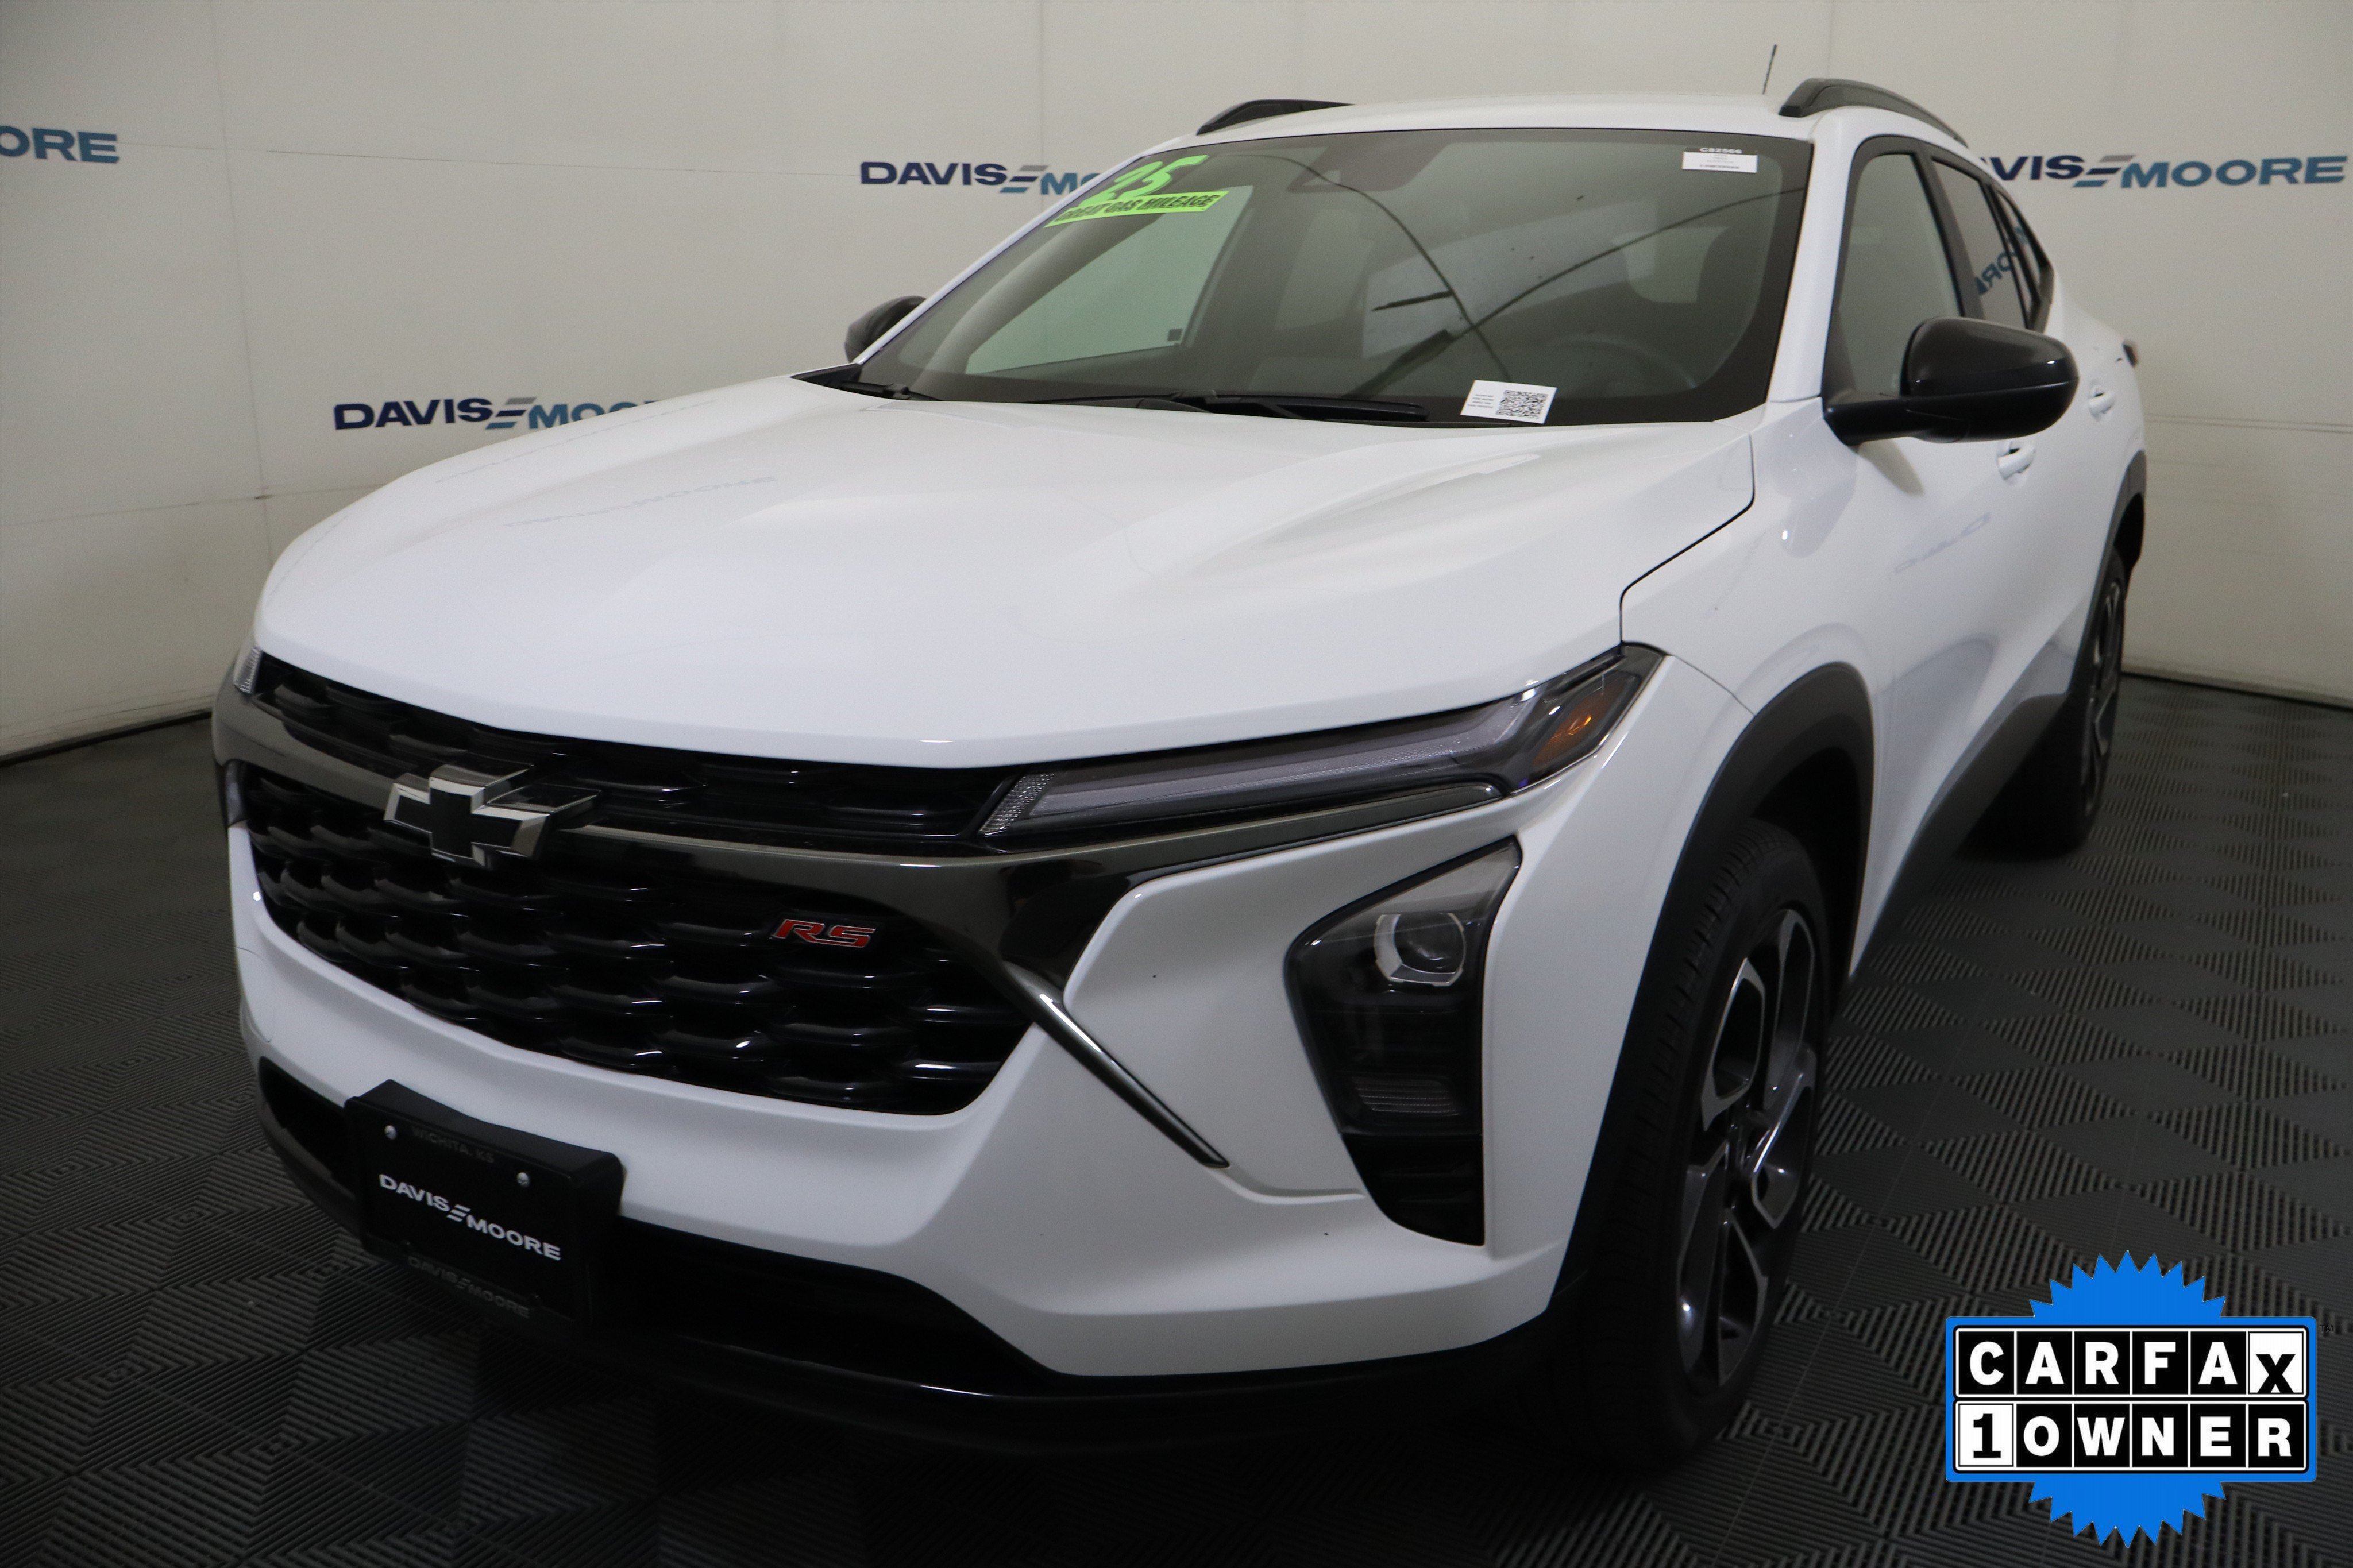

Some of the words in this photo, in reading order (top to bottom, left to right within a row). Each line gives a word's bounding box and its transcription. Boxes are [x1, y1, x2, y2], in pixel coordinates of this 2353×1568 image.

[860, 161, 1006, 185] DAVIS
[2120, 155, 2348, 188] MOORE
[1104, 199, 1144, 214] GAS
[1137, 194, 1221, 211] MILEAGE
[333, 397, 493, 430] DAVIS
[773, 918, 877, 948] RS
[378, 1173, 451, 1212] DAVIS
[466, 1214, 562, 1261] MOORE
[407, 1256, 458, 1283] DAVIS
[468, 1284, 530, 1319] MOORE
